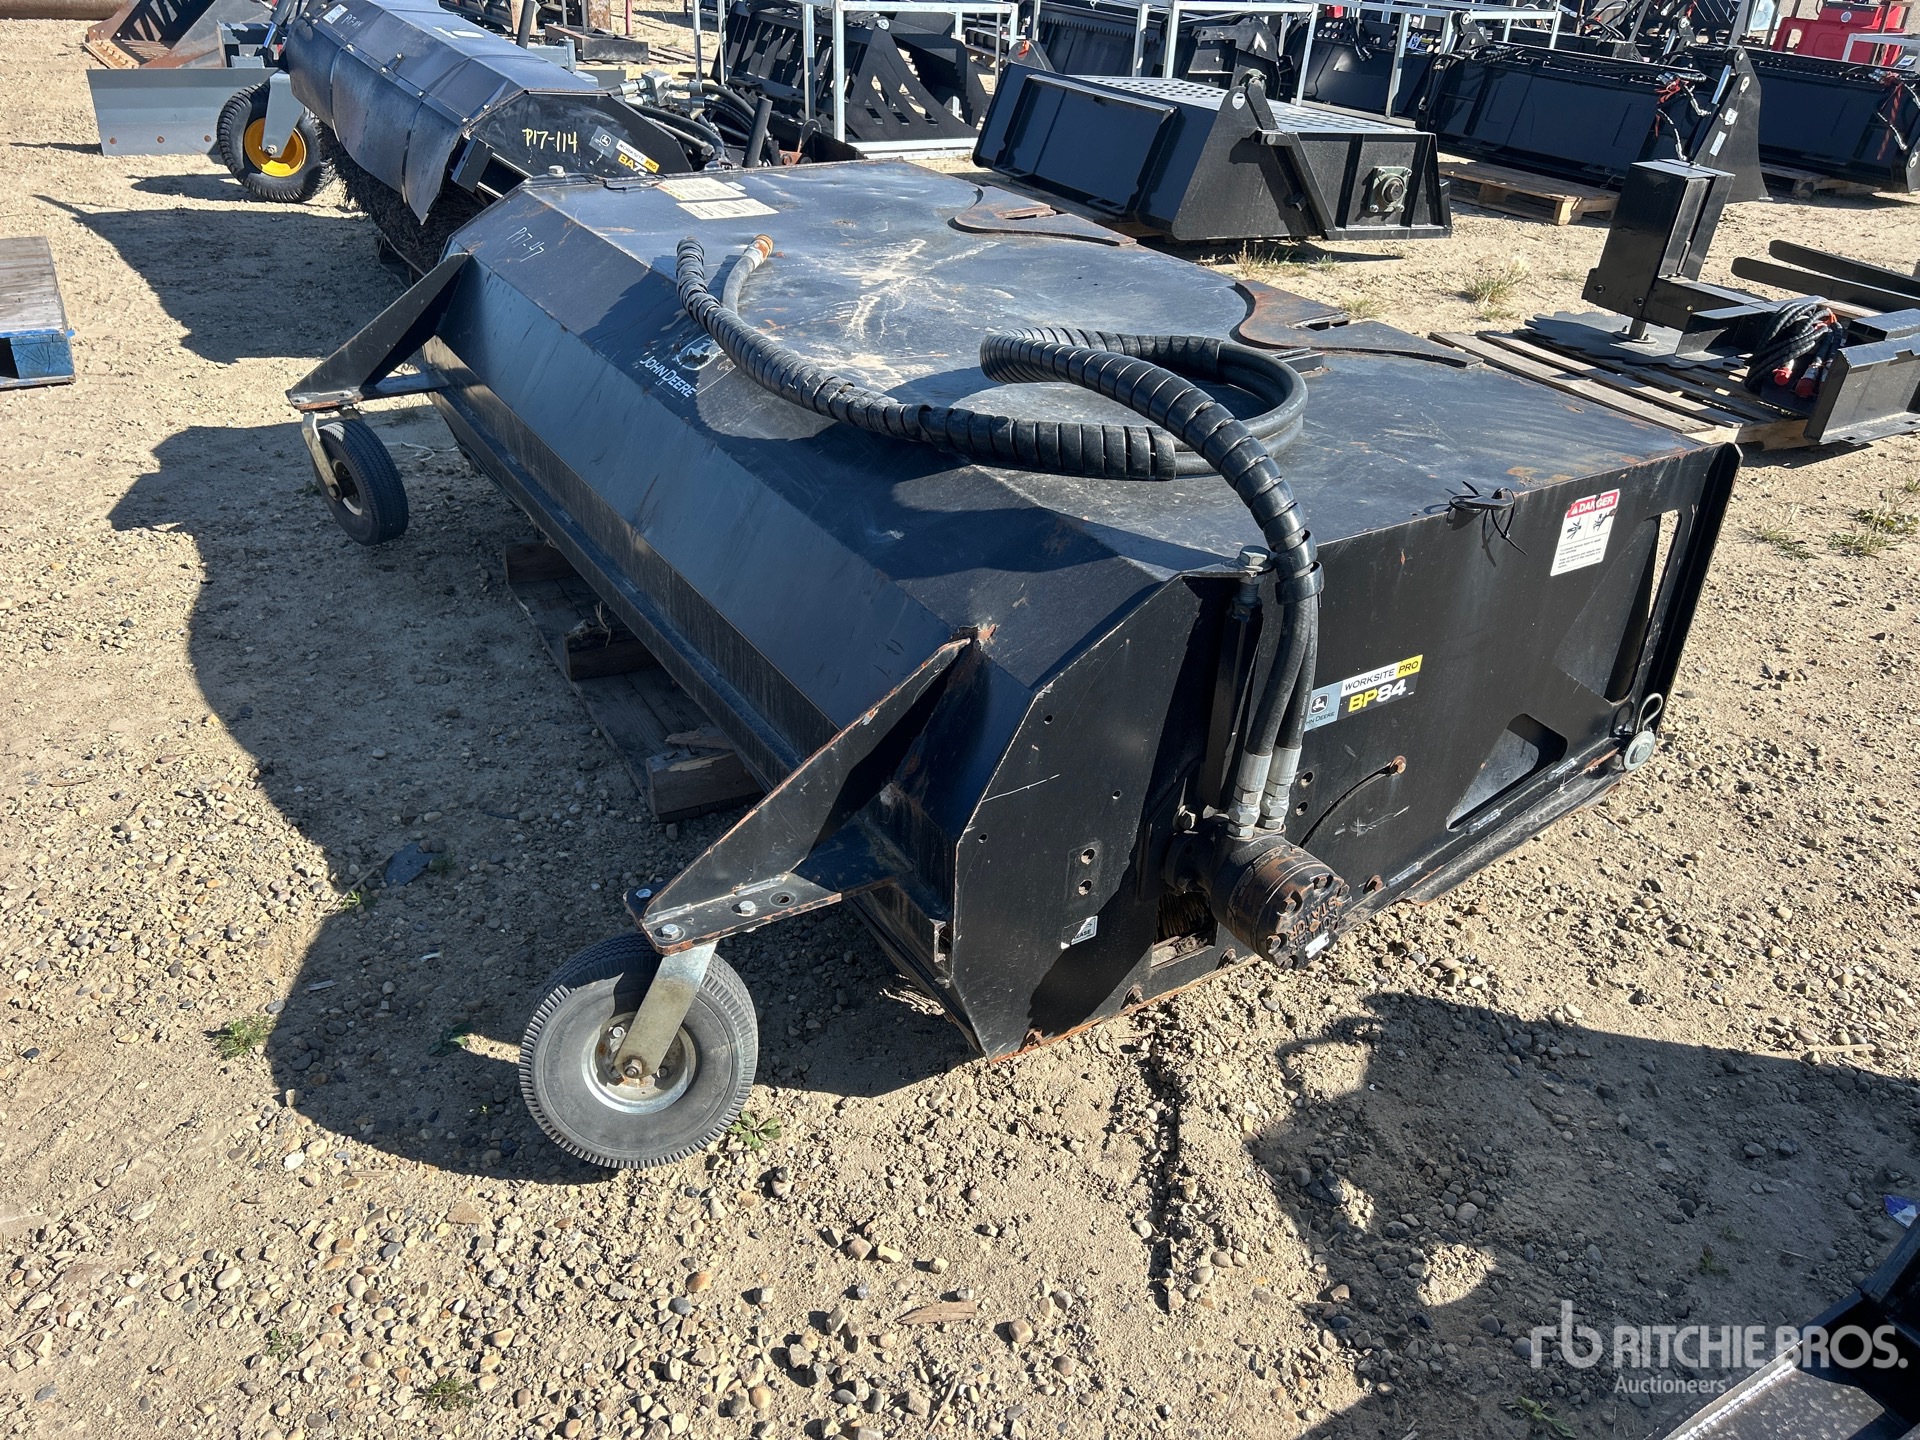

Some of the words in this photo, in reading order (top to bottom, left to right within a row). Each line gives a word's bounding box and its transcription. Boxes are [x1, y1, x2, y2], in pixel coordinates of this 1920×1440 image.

[522, 128, 578, 153] P17-114
[617, 153, 648, 177] BA72
[618, 142, 645, 163] WORKSITE
[644, 157, 659, 172] PRO
[506, 226, 545, 262] P17-47
[640, 355, 668, 377] JOHN
[662, 369, 697, 397] DEERE
[1580, 496, 1614, 512] DANGER
[1344, 668, 1395, 691] WORKSITE
[1398, 660, 1419, 674] PRO
[1348, 678, 1407, 712] BP84
[1315, 711, 1335, 722] DEERE
[1286, 896, 1342, 942] STATOR
